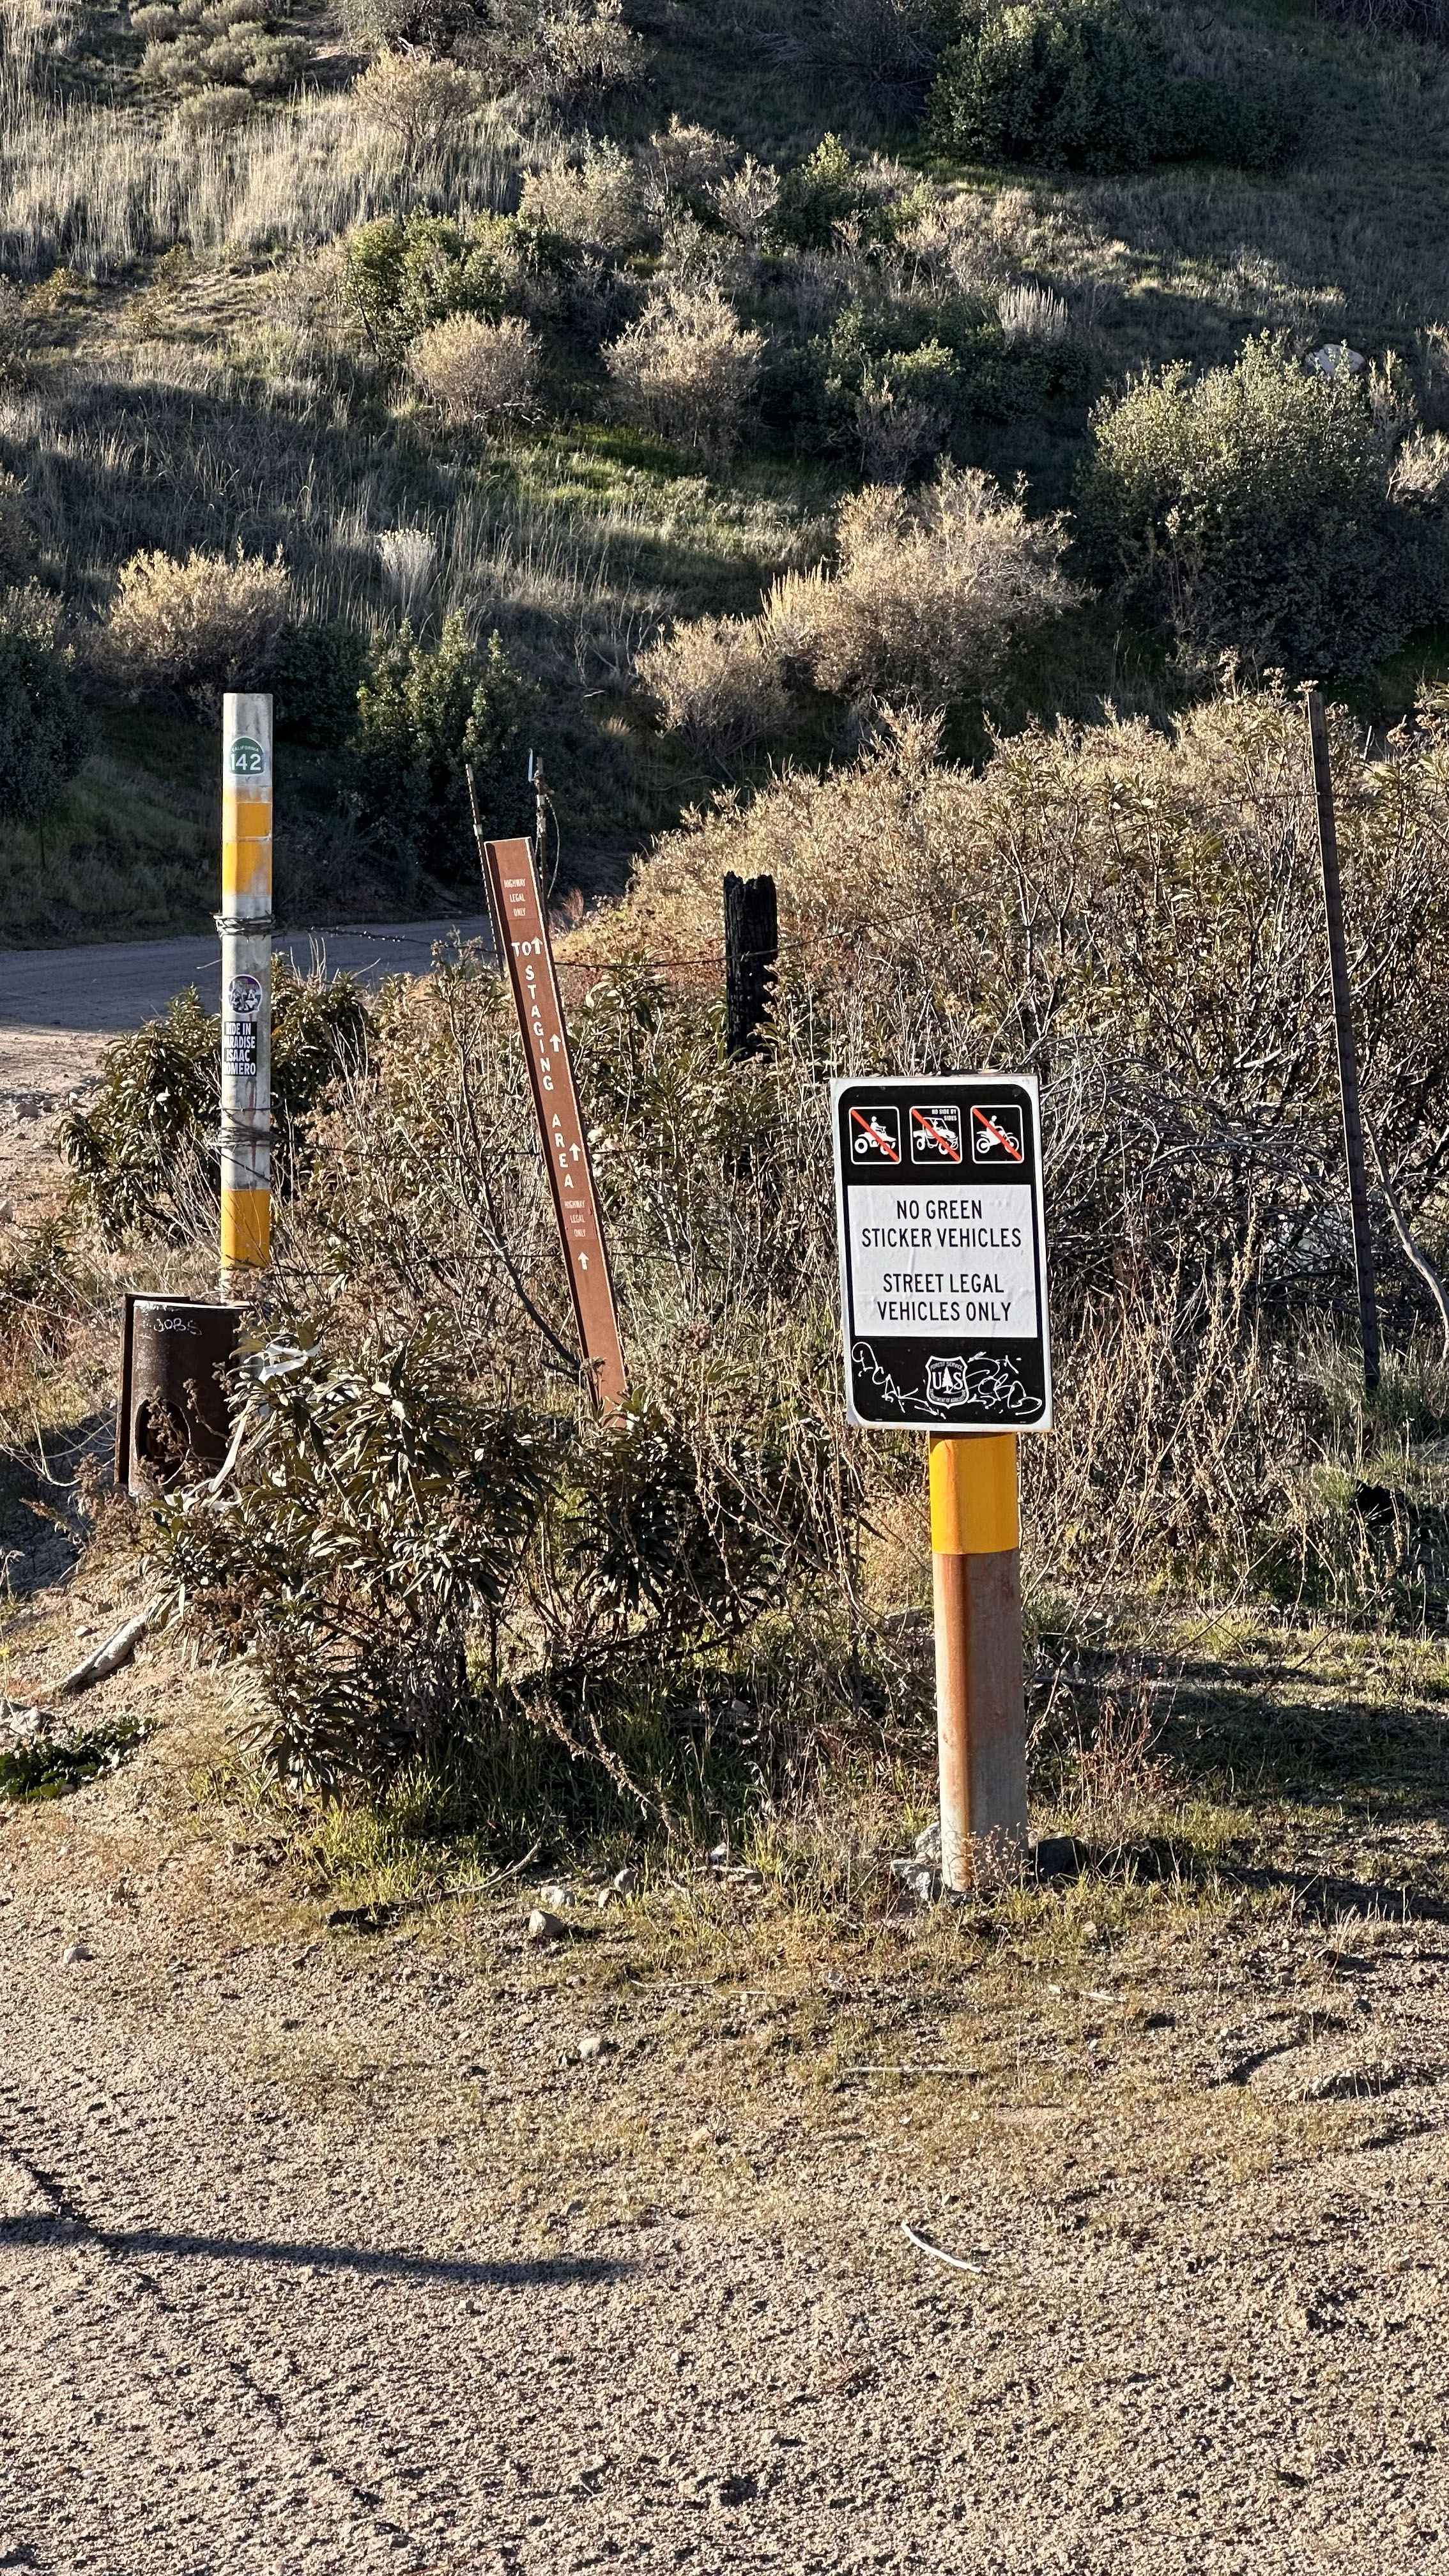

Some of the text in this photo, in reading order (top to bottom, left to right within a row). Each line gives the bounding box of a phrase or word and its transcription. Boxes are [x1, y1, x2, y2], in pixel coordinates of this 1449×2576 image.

[231, 754, 261, 770] 142
[510, 893, 526, 902] LEGAL
[513, 907, 526, 917] ONLY
[511, 941, 532, 957] TO
[243, 1023, 251, 1035] IN
[224, 1036, 256, 1048] RADISE
[226, 1049, 250, 1062] ISAAC
[224, 1062, 256, 1075] OMERO
[525, 965, 574, 1188] STAGING AREA
[897, 1200, 982, 1219] NO GREEN
[570, 1215, 586, 1223] LEGAL
[862, 1228, 1022, 1247] STICKER VEHICLES
[883, 1273, 1004, 1293] STREET LEGAL
[877, 1301, 1011, 1321] VEHICLES ONLY
